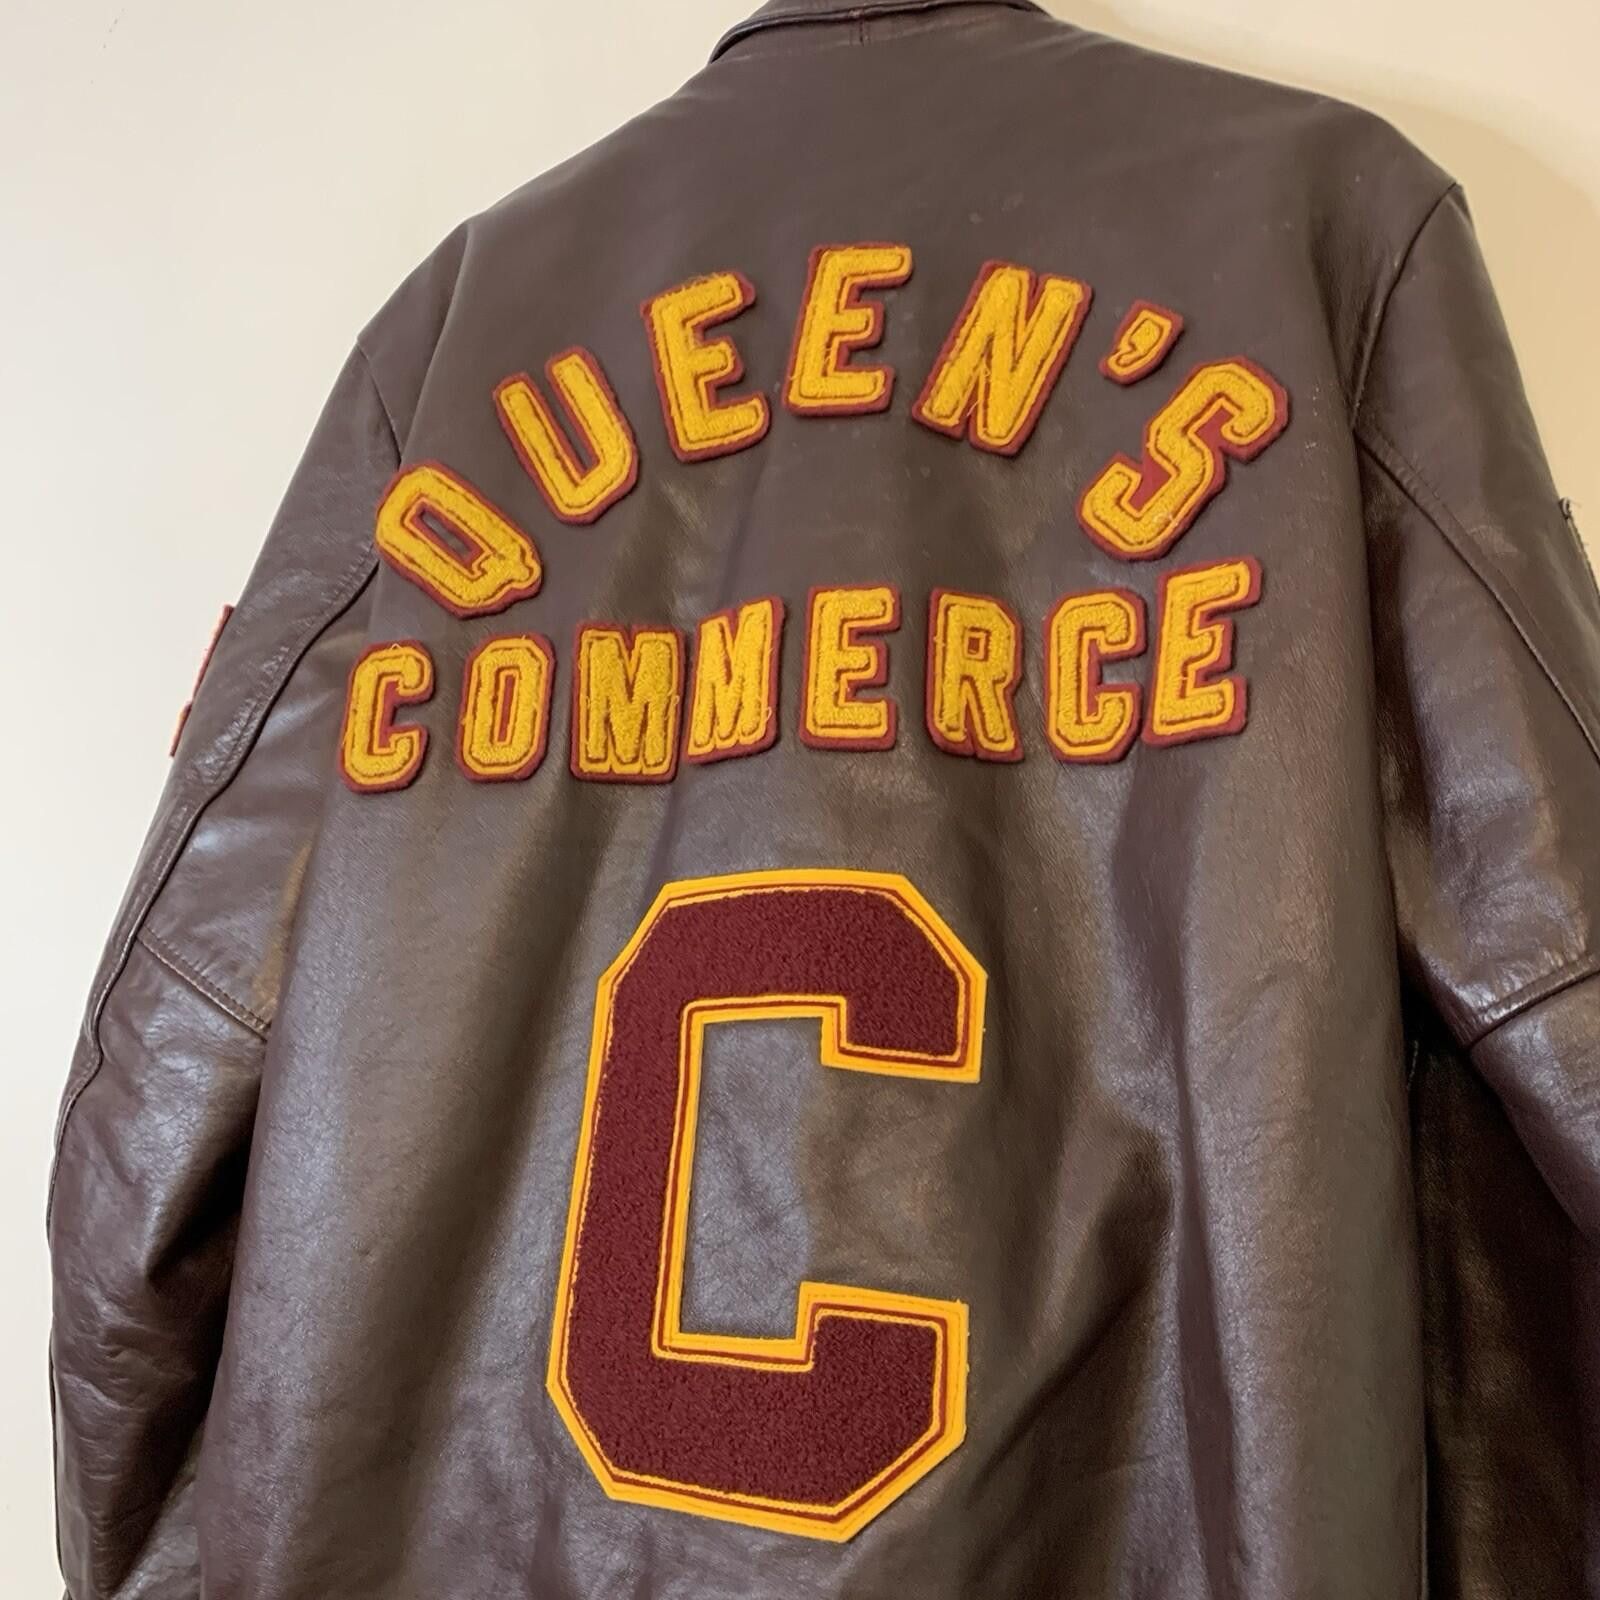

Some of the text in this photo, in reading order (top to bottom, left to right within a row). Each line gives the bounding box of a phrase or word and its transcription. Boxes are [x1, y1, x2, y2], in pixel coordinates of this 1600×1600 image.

[376, 243, 1289, 616] QUEEN'S
[340, 558, 1260, 791] COMMERCE
[546, 868, 988, 1543] C
